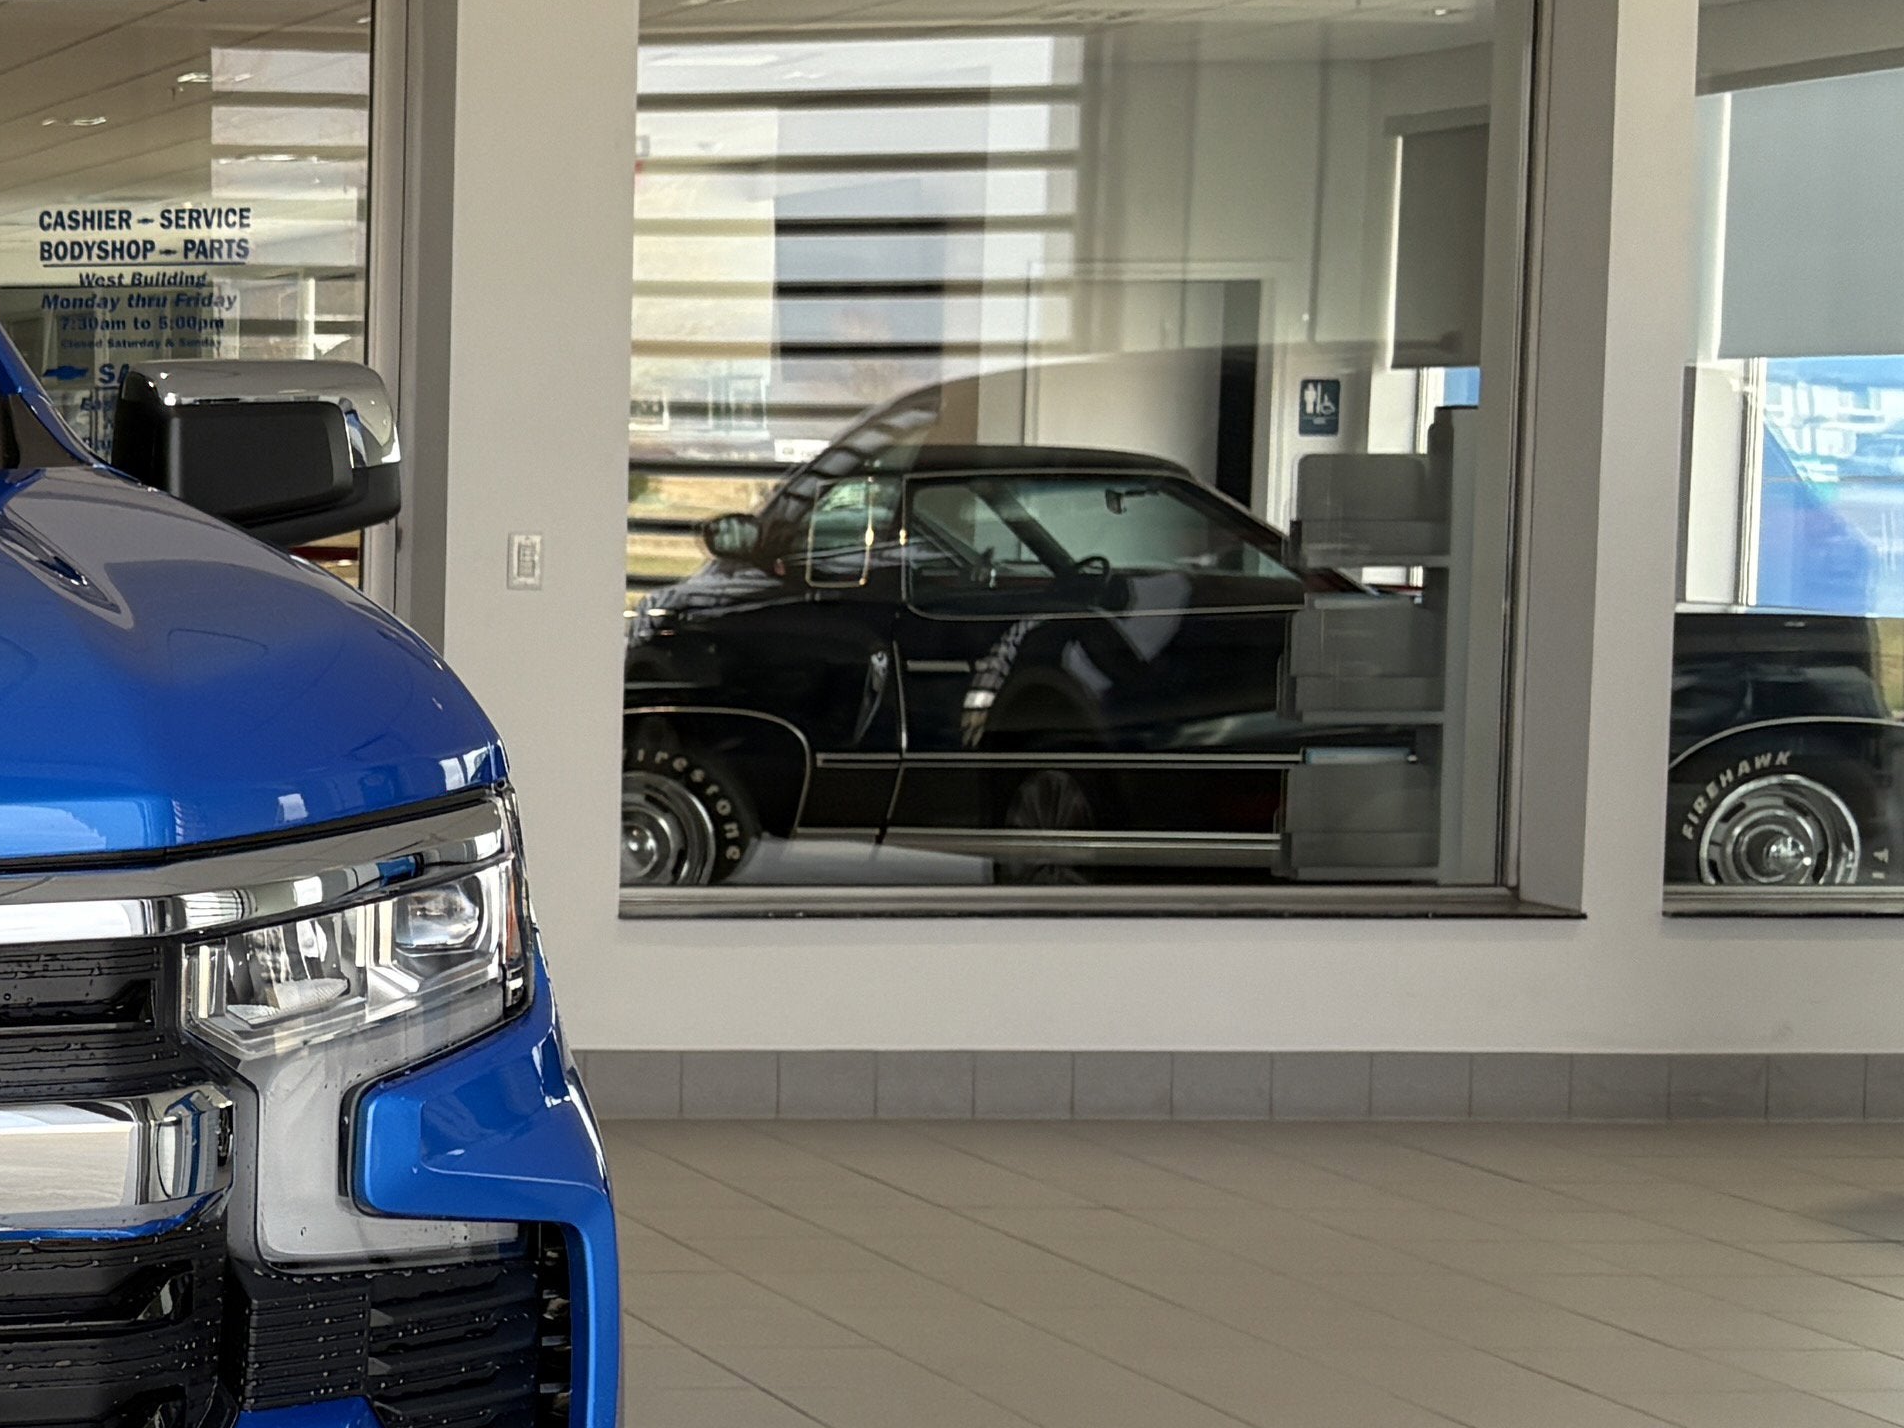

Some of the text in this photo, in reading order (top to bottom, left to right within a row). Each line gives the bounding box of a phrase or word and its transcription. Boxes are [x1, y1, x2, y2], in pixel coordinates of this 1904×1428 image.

[39, 207, 251, 231] CASHIER SERVICE
[40, 238, 250, 261] BODYSHOP PARTS
[79, 271, 208, 288] West Building
[42, 292, 237, 311] Monday thru Friday
[133, 316, 151, 330] to
[107, 338, 161, 349] Saturday
[1682, 751, 1791, 840] FIREHAWK
